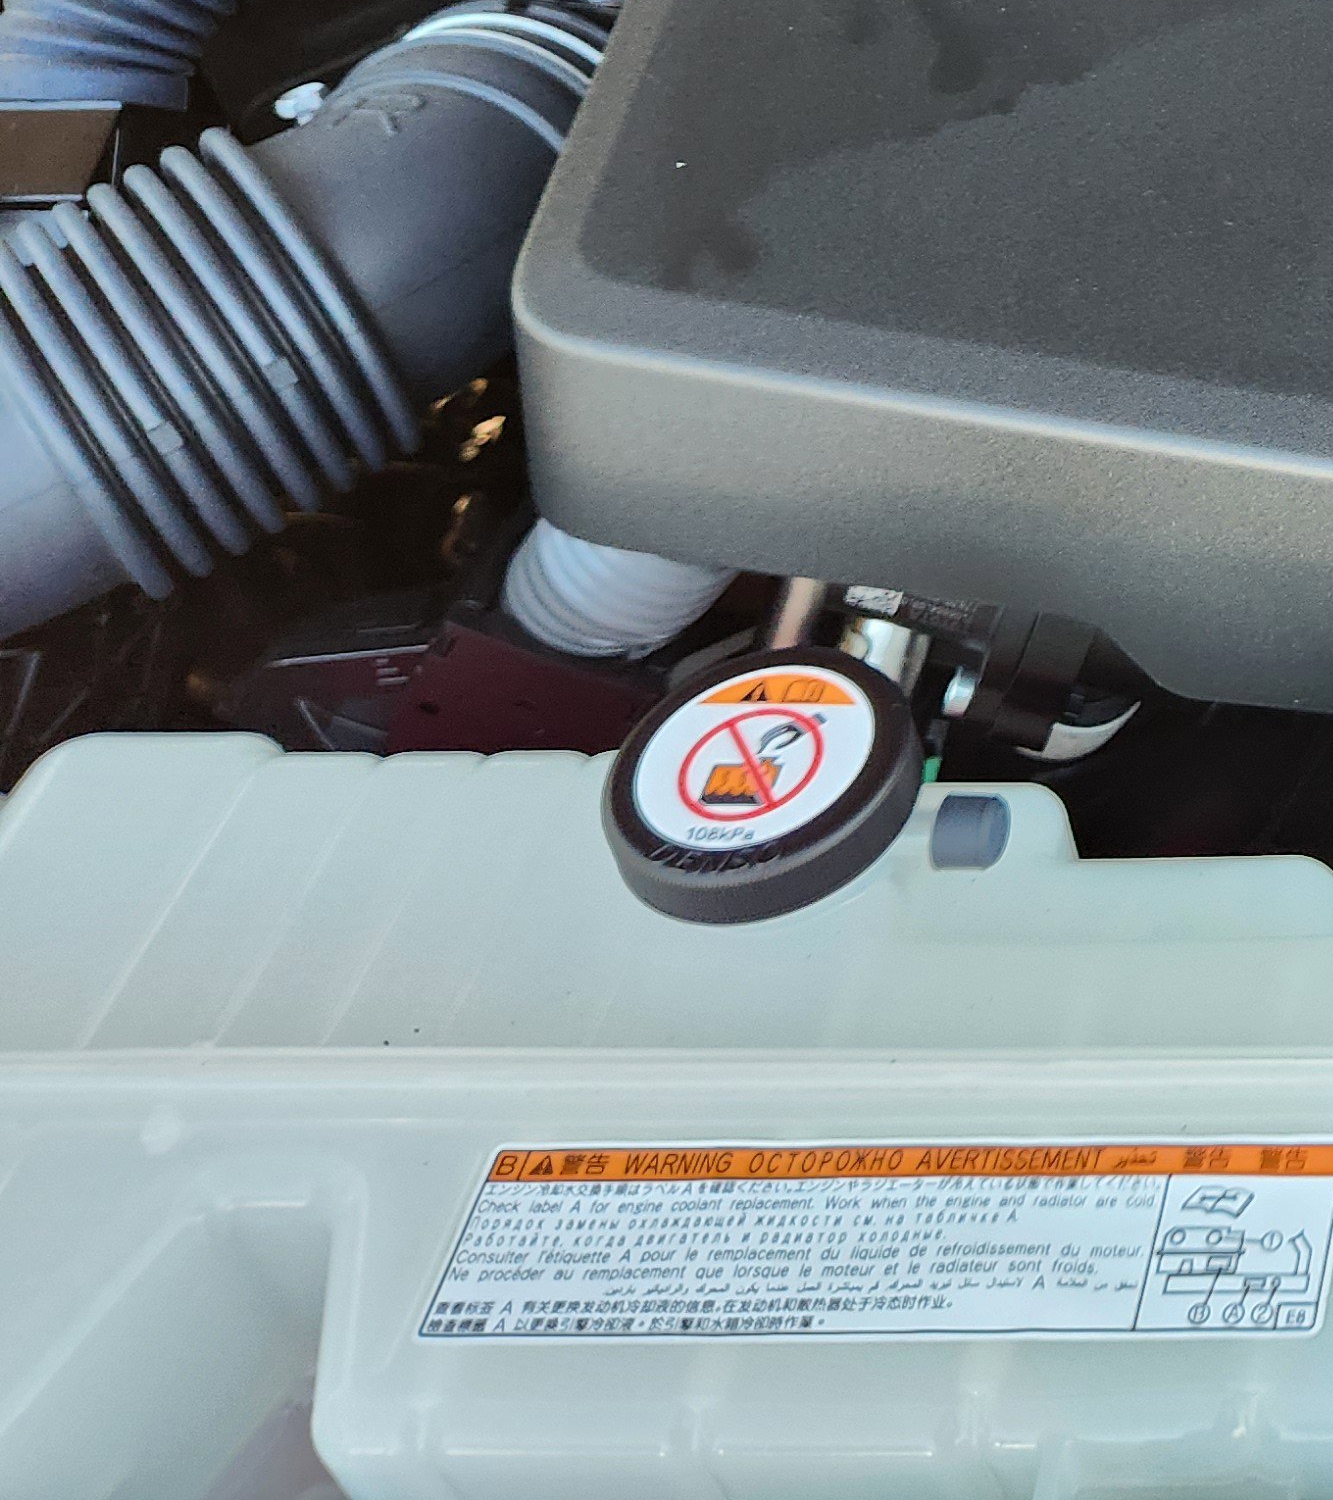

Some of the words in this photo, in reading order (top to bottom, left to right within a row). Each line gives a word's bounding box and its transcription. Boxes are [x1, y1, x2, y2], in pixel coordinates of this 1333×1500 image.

[496, 1155, 519, 1176] B
[624, 1152, 734, 1176] WARNING
[749, 1149, 905, 1174] ОСТОРОЖНО
[915, 1148, 1104, 1171] AVERTISSEMENT
[478, 1200, 521, 1214] Check
[529, 1200, 563, 1213] label
[569, 1201, 582, 1213] A
[589, 1200, 611, 1213] for
[617, 1201, 663, 1216] engine
[671, 1199, 721, 1213] coolant
[825, 1197, 861, 1210] Work
[871, 1197, 907, 1210] when
[915, 1194, 937, 1208] the
[945, 1194, 991, 1209] engine
[998, 1194, 1025, 1207] and
[1032, 1194, 1088, 1207] radiator
[1095, 1196, 1117, 1208] are
[572, 1233, 626, 1247] когда
[456, 1250, 529, 1265] Consulter
[619, 1249, 632, 1262] A
[640, 1250, 677, 1265] pour
[684, 1249, 699, 1261] le
[707, 1248, 812, 1262] remplacement
[820, 1248, 840, 1260] du
[850, 1245, 900, 1260] liquide
[909, 1244, 928, 1257] de
[936, 1242, 1051, 1257] refroidissement
[1060, 1243, 1082, 1257] du
[449, 1267, 469, 1281] Ne
[477, 1267, 546, 1282] procéder
[553, 1268, 574, 1281] au
[582, 1266, 687, 1282] remplacement
[695, 1267, 724, 1279] que
[733, 1264, 790, 1279] lorsque
[798, 1264, 812, 1277] le
[821, 1262, 874, 1277] moteur
[884, 1261, 899, 1275] et
[907, 1261, 921, 1274] le
[930, 1259, 998, 1273] radiateur
[1008, 1259, 1042, 1272] sont
[1031, 1276, 1046, 1290] A
[499, 1300, 513, 1315] A
[492, 1318, 506, 1332] A
